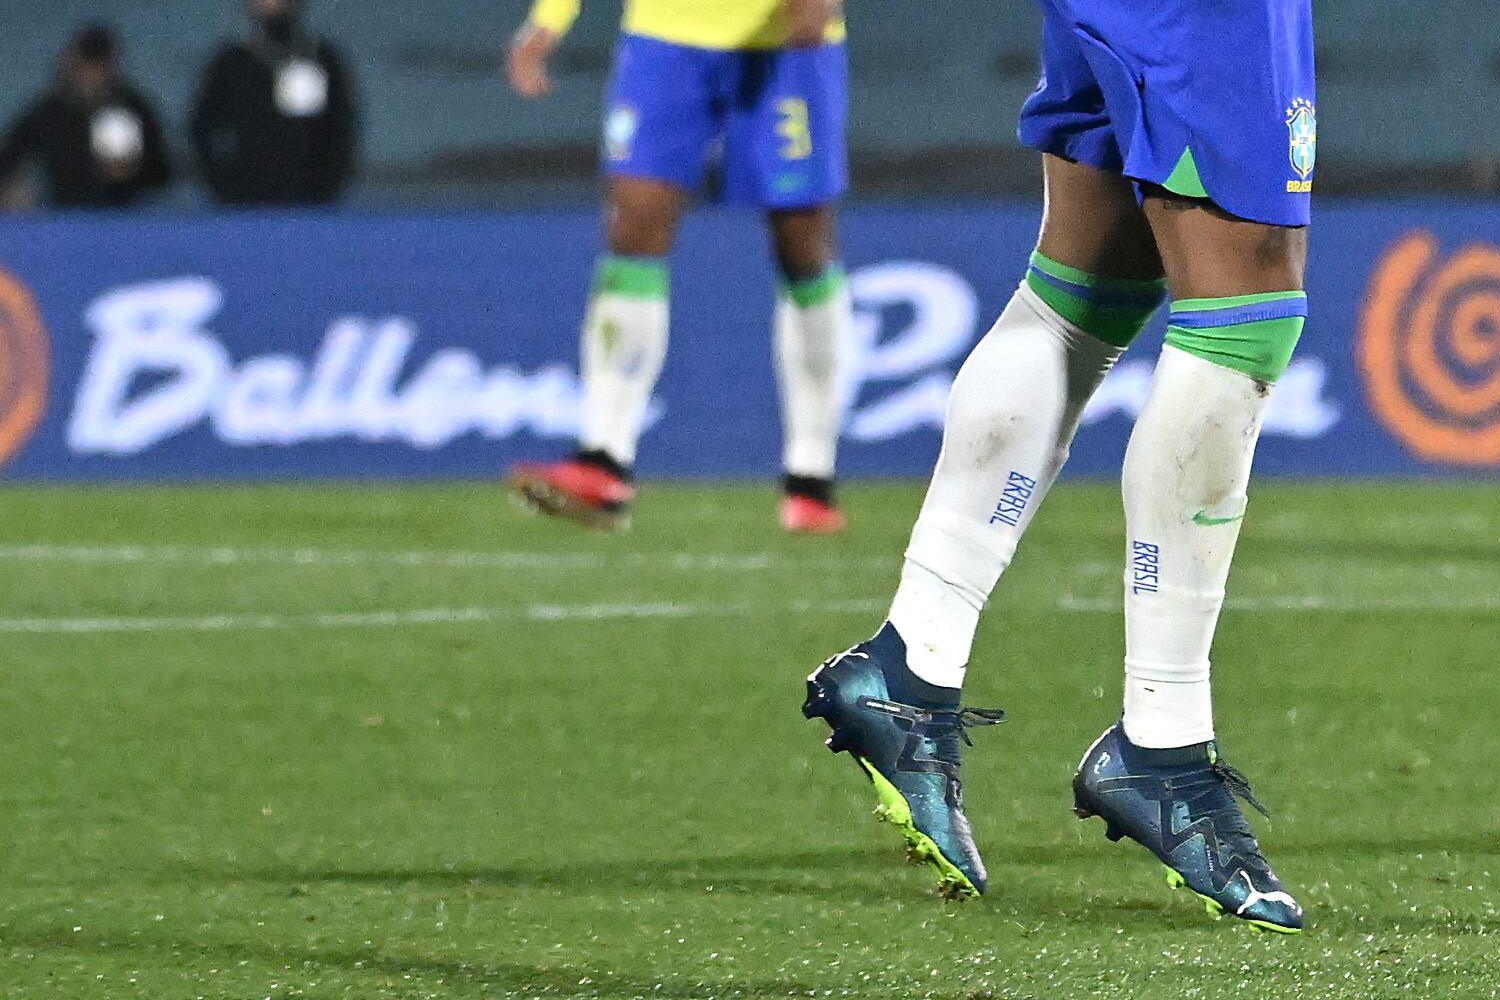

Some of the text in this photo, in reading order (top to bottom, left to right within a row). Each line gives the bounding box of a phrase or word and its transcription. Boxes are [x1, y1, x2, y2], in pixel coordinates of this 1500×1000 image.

[776, 97, 813, 161] 3
[66, 275, 664, 453] Ballen
[990, 471, 1036, 527] BRASIL
[1133, 541, 1159, 595] BRASIL
